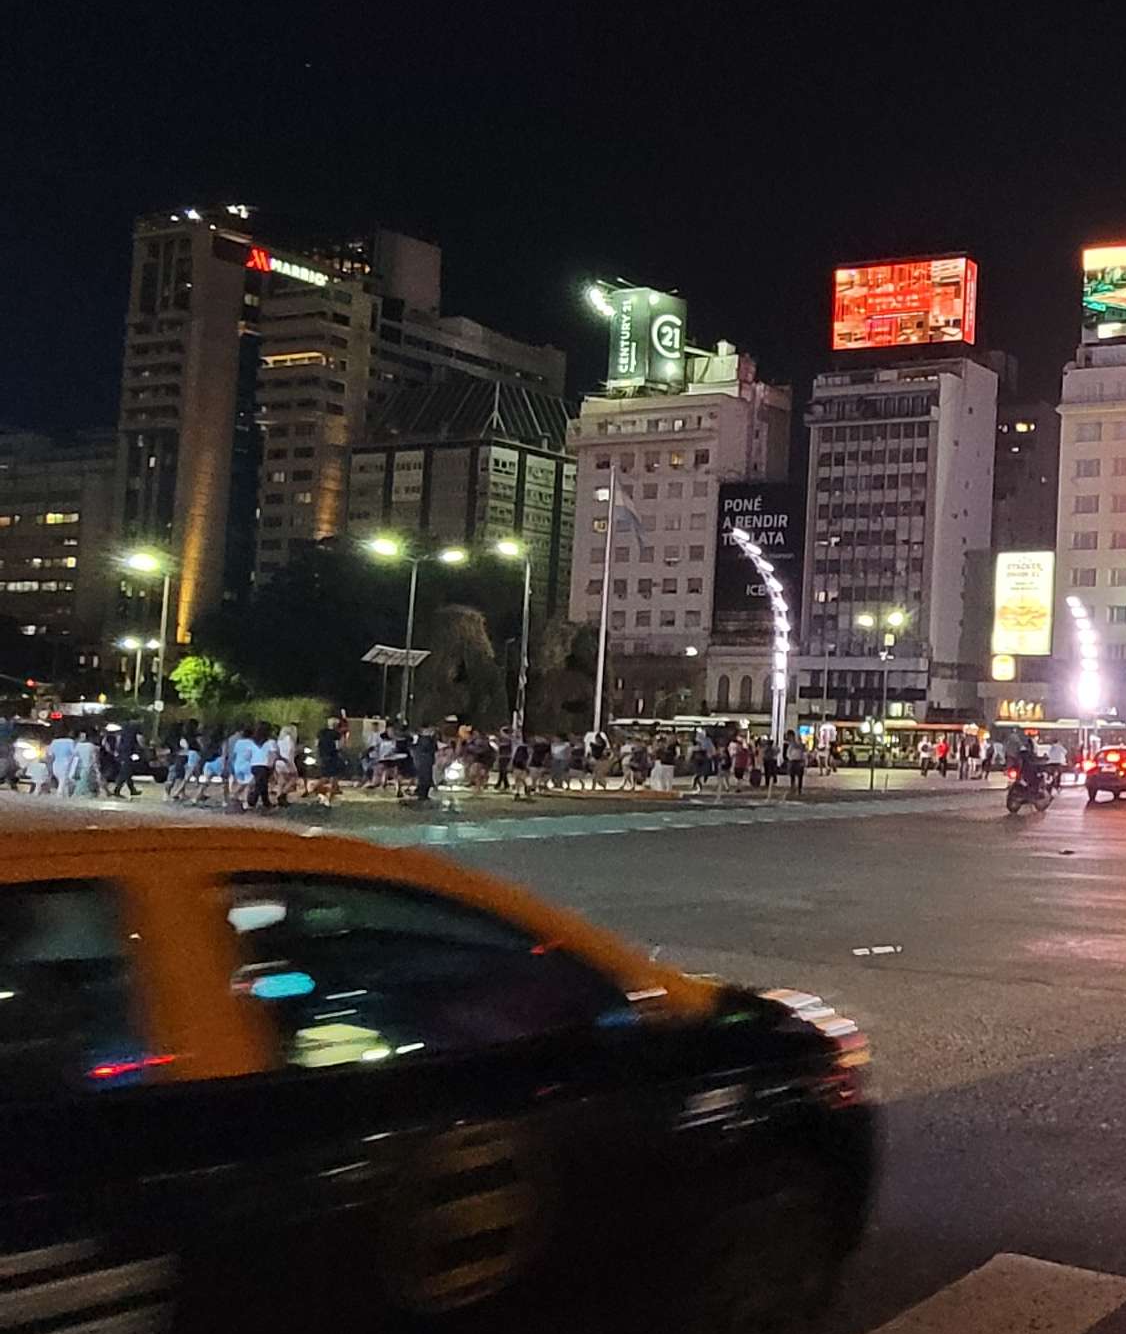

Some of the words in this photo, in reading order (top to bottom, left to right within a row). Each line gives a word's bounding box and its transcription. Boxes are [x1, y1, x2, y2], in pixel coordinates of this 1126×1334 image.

[622, 299, 633, 314] 21
[617, 314, 632, 374] CENTURY
[723, 494, 762, 513] PONÉ
[722, 515, 732, 529] A
[734, 514, 789, 529] RENDIR
